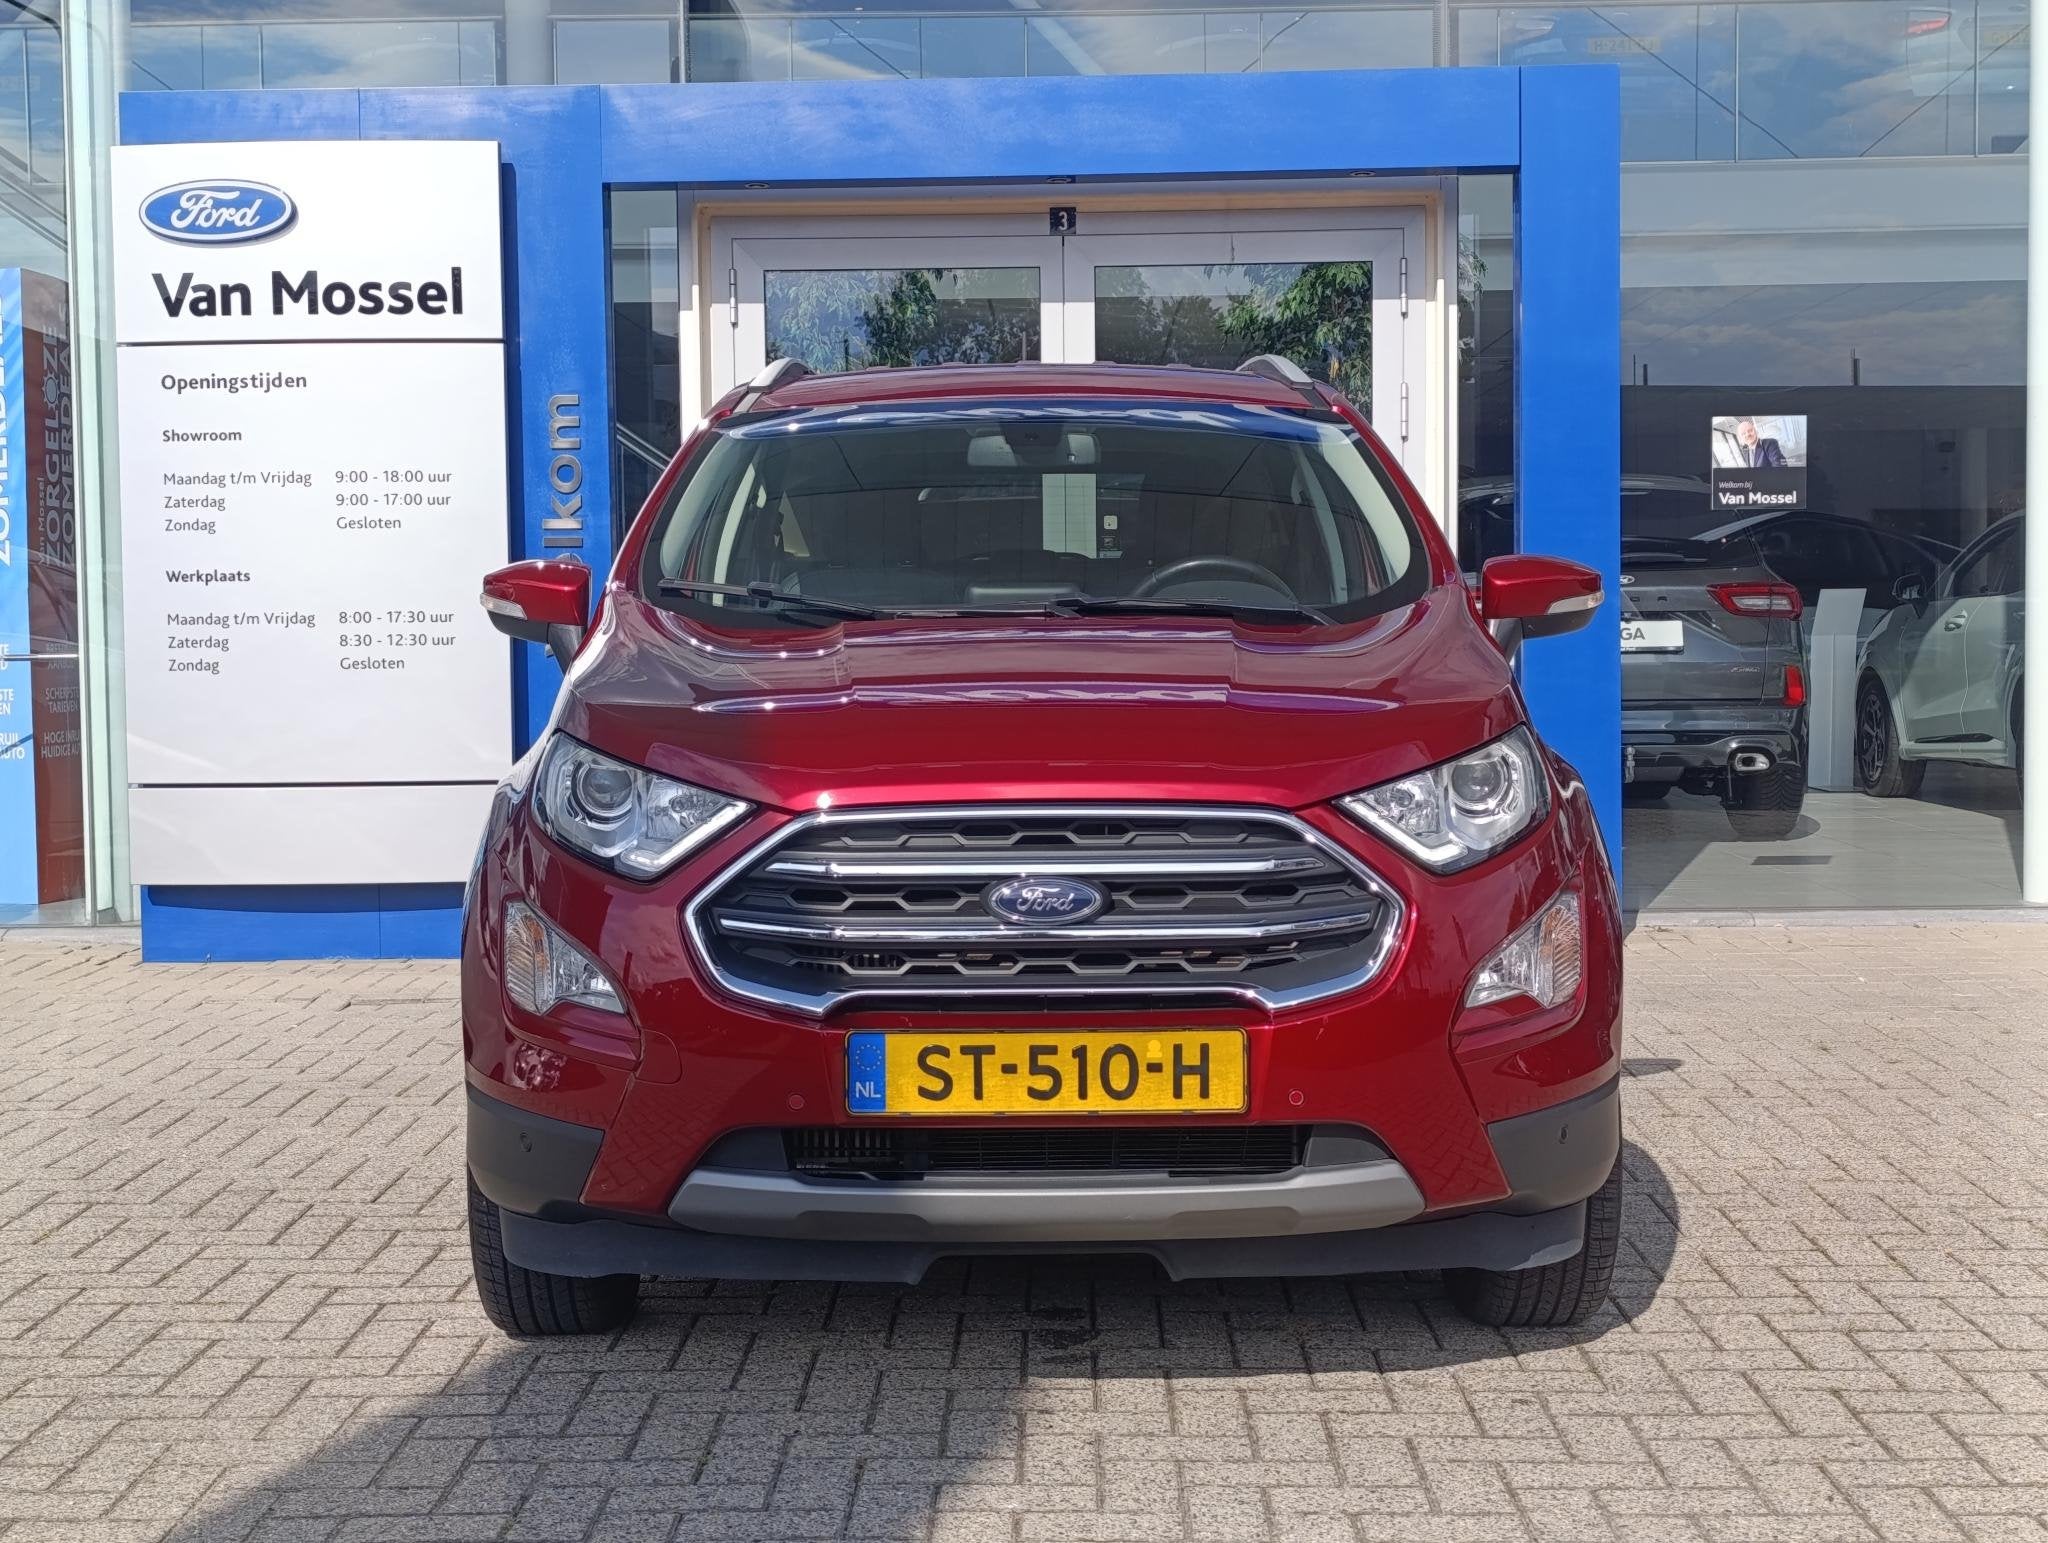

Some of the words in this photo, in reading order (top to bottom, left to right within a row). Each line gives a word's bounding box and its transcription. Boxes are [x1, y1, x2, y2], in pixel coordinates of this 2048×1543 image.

[171, 190, 263, 229] Ford
[1059, 211, 1068, 231] 3
[151, 271, 252, 318] Van
[271, 266, 463, 315] Mossel
[161, 371, 308, 395] Openingstijden
[162, 429, 243, 443] Showroom
[163, 471, 227, 489] Maandag
[230, 471, 257, 485] t/m
[260, 470, 313, 488] Vrijdag
[335, 470, 369, 484] 9:00
[382, 469, 424, 483] 18:00
[427, 473, 453, 483] uur
[37, 477, 45, 535] Mossel
[164, 494, 226, 512] Zaterdag
[335, 493, 369, 507] 9:00
[383, 492, 423, 506] 17:00
[427, 495, 452, 506] uur
[1719, 492, 1745, 505] Van
[1748, 490, 1797, 504] Mossel
[164, 517, 217, 535] Zondag
[336, 515, 402, 530] Gesloten
[541, 393, 584, 657] lkom
[165, 568, 251, 587] Werkplaats
[167, 611, 231, 630] Maandag
[232, 611, 260, 626] t/m
[263, 610, 316, 629] Vrijdag
[338, 611, 372, 625] 8:00
[386, 610, 426, 624] 17:30
[430, 613, 455, 623] uur
[167, 635, 230, 653] Zaterdag
[339, 633, 373, 648] 8:30
[386, 633, 428, 647] 12:30
[431, 636, 457, 646] uur
[168, 657, 221, 676] Zondag
[339, 656, 405, 670] Gesloten
[44, 730, 65, 745] HOGE
[1016, 886, 1074, 913] Ford
[917, 1042, 1210, 1101] ST-510-H
[855, 1081, 881, 1098] NL
